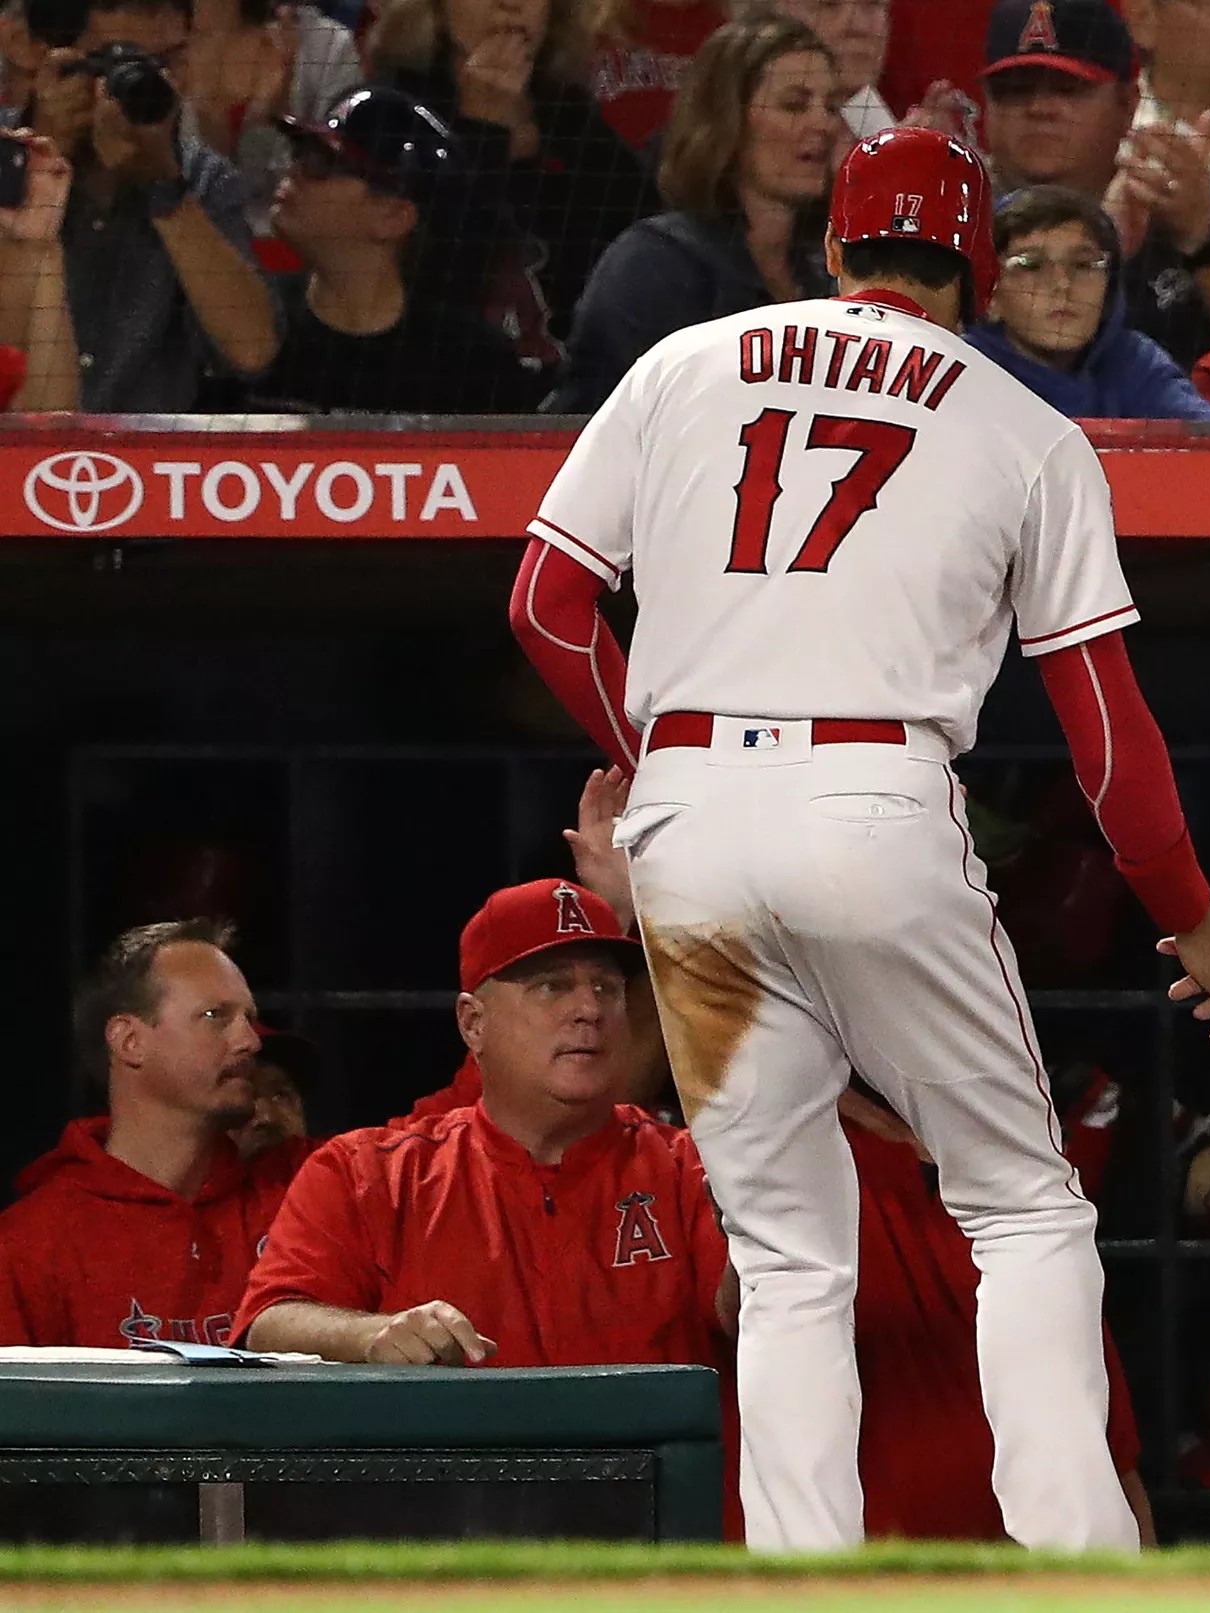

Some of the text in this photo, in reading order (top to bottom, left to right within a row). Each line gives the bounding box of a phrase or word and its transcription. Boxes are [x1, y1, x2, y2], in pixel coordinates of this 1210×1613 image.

[1017, 0, 1059, 52] A
[895, 193, 923, 216] 17
[740, 325, 967, 411] OHTANI
[153, 462, 478, 522] TOYOTA
[723, 407, 918, 574] 17
[552, 881, 595, 933] A
[611, 1191, 672, 1267] A
